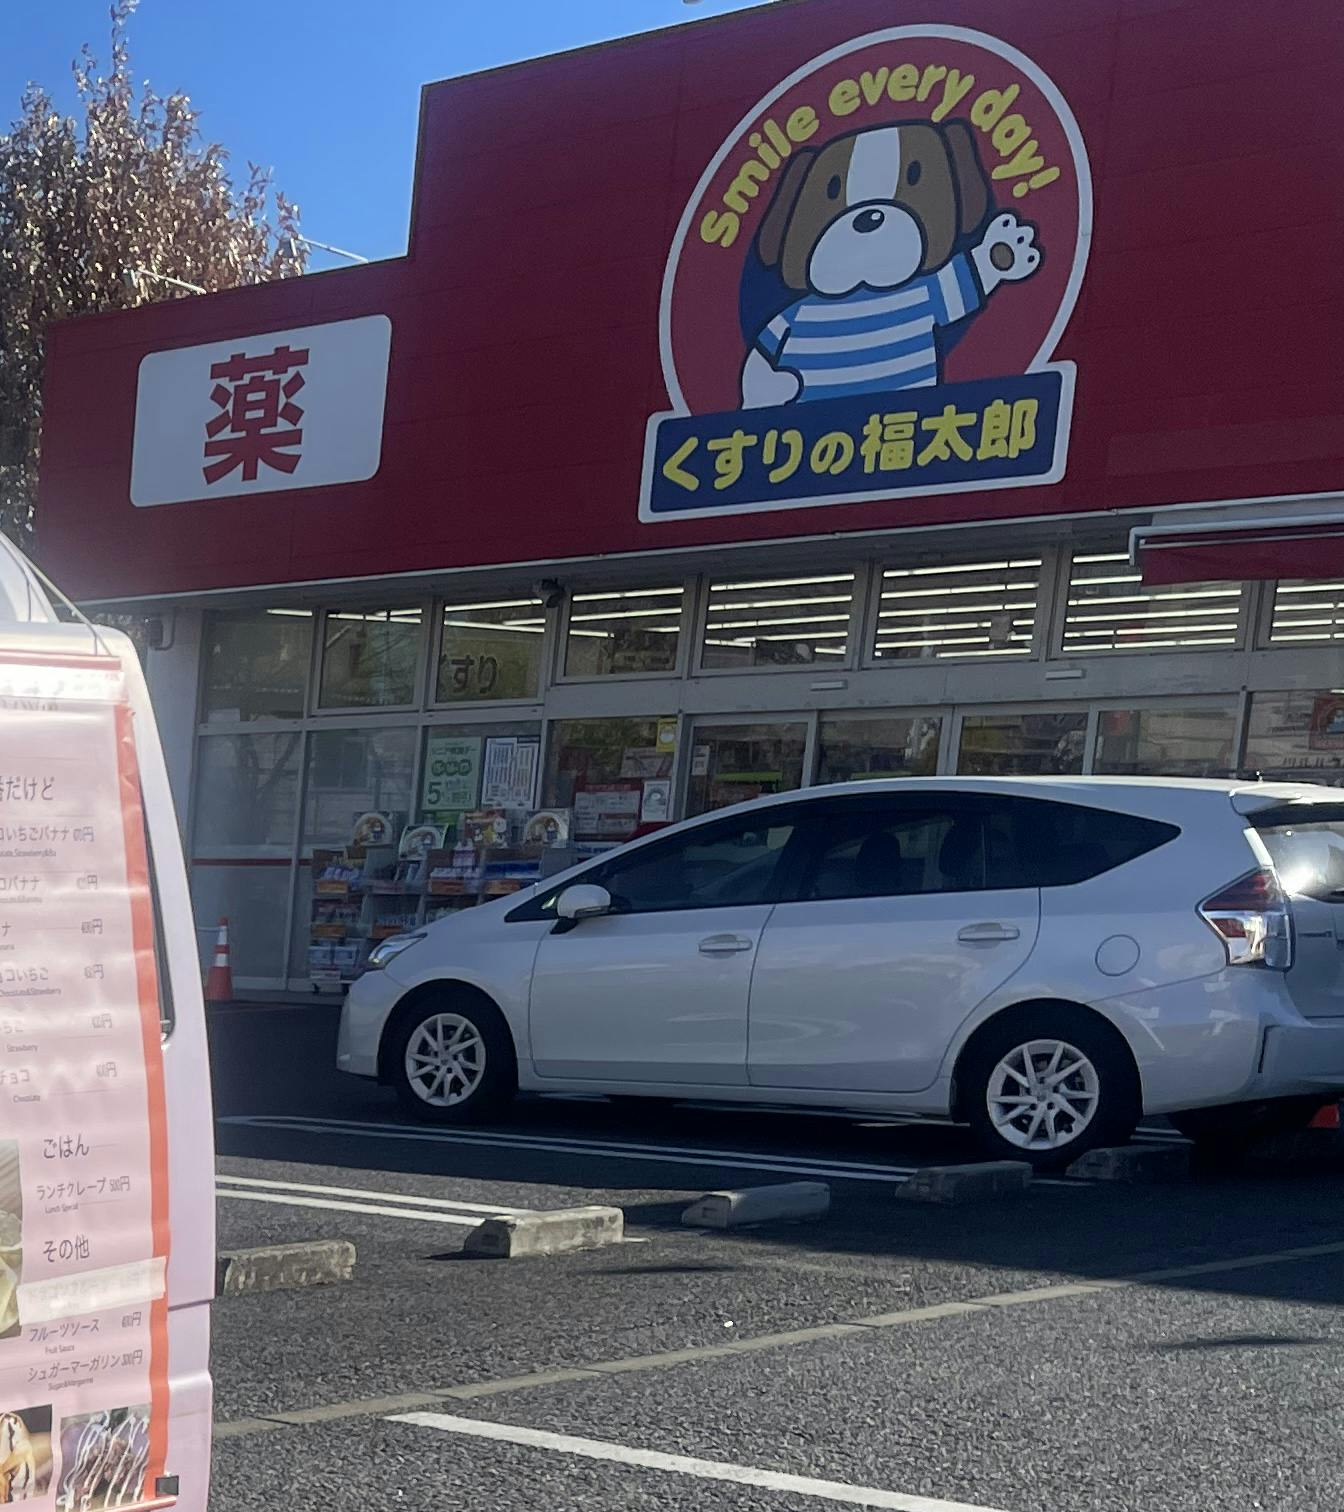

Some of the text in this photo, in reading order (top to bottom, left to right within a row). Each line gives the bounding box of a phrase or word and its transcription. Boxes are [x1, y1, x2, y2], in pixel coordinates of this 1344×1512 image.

[699, 62, 1061, 248] Smile every day!
[202, 344, 310, 486] 薬
[662, 398, 1039, 492] くすりの福太郎
[43, 1133, 90, 1159] ごはん
[36, 1176, 107, 1201] ランチクレープ
[42, 1233, 90, 1263] その他
[29, 1318, 100, 1342] フルーツソース
[27, 1353, 120, 1383] シュガーマーガリン
